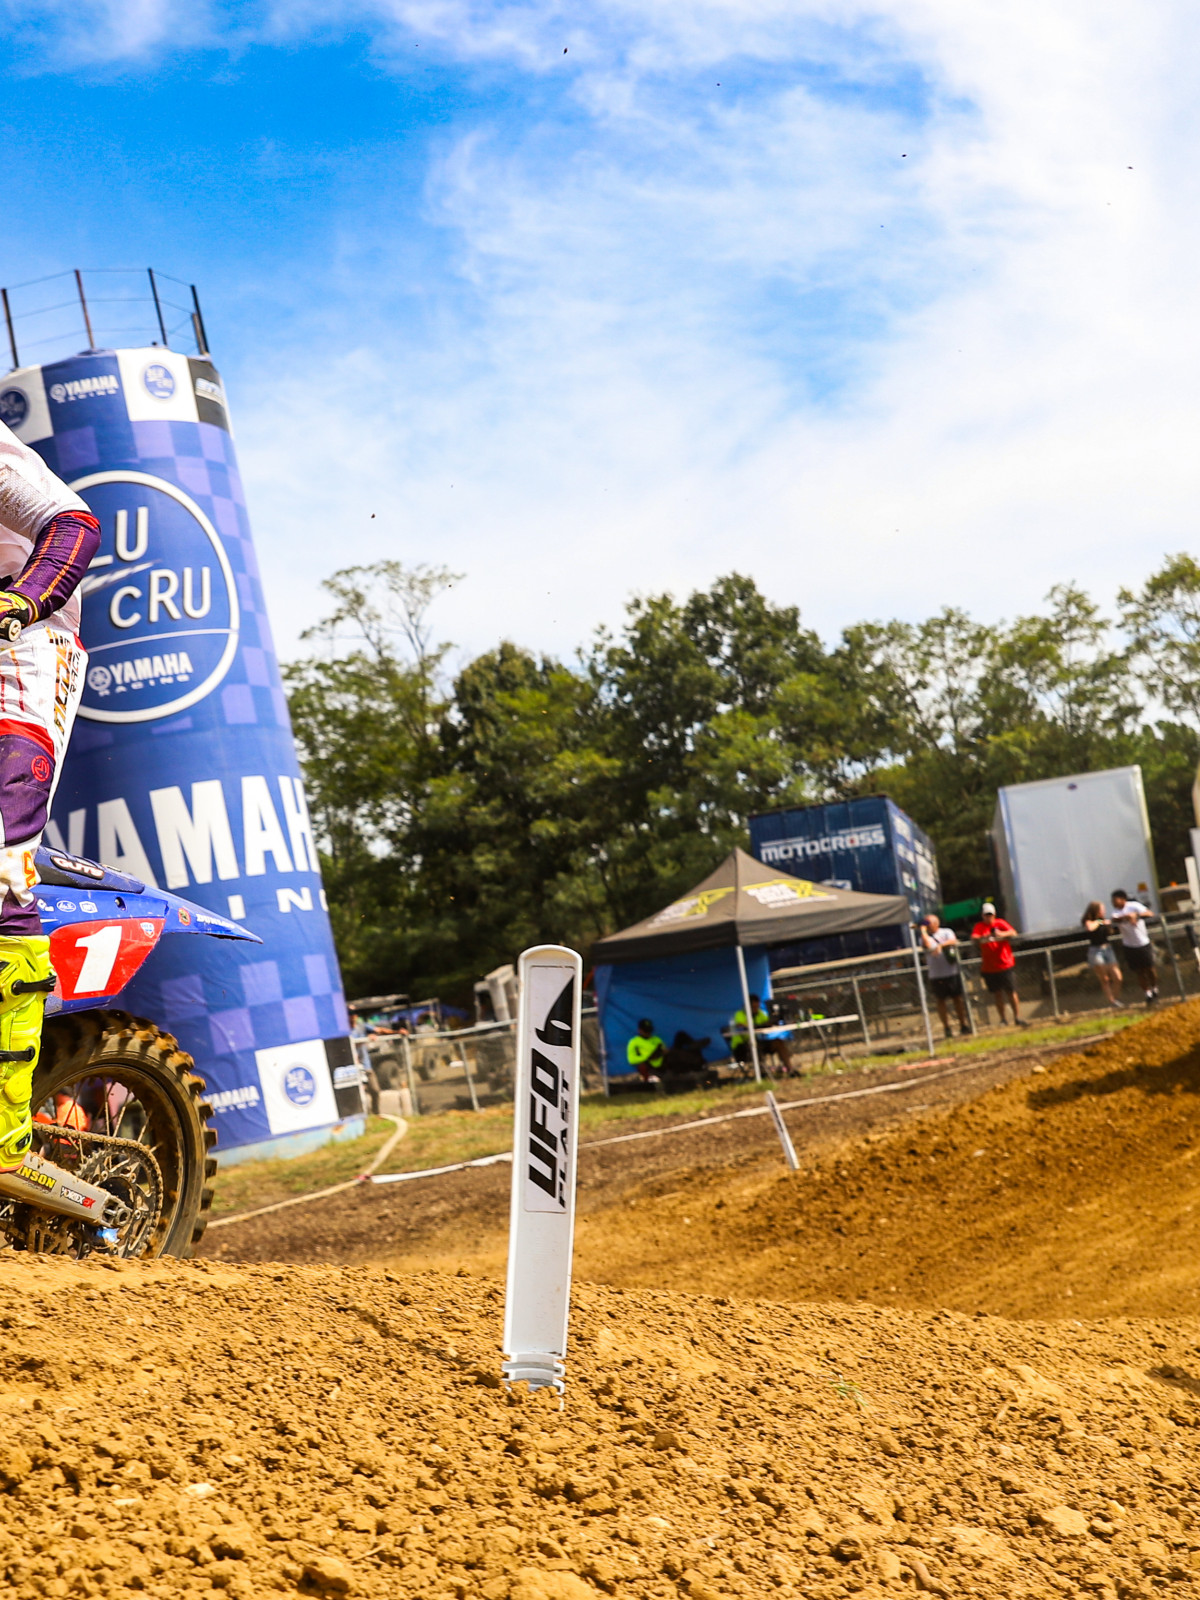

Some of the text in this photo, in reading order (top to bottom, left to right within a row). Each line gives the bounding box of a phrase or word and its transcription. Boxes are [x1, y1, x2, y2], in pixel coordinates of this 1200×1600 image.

[66, 375, 119, 397] YAMAHA
[109, 566, 211, 629] CRU
[109, 651, 194, 685] YAMAHA
[43, 774, 321, 890] YAMAH
[760, 829, 886, 863] MOTOCROSS
[73, 926, 122, 994] 1
[528, 1048, 560, 1199] UFO
[16, 1166, 56, 1189] INSON
